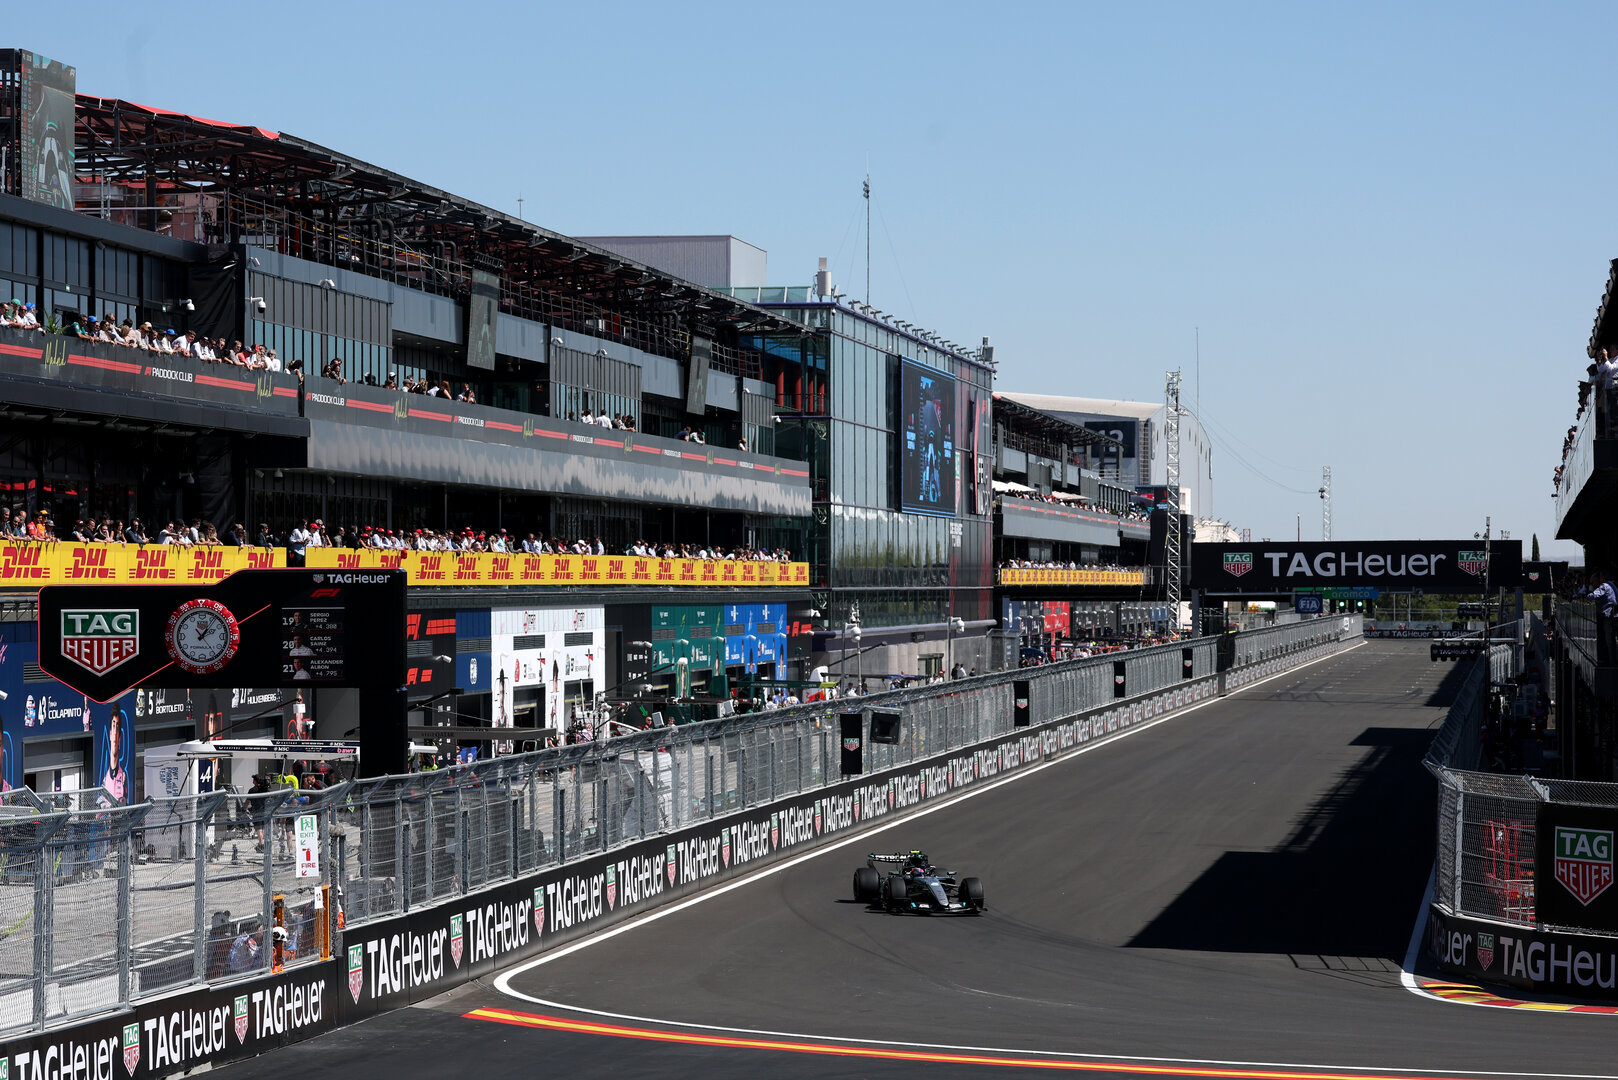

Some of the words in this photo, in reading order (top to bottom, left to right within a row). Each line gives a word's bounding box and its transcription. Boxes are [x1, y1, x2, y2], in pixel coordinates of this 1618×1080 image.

[151, 367, 179, 380] PADDOCK
[178, 373, 193, 382] CLUB
[312, 393, 333, 405] PADDOCK
[333, 397, 345, 406] CLUB
[1, 547, 44, 579] DHL
[70, 548, 112, 579] DHL
[134, 550, 171, 579] DHL
[192, 551, 227, 579] DHL
[419, 556, 443, 580] DHL
[456, 557, 478, 580] DHL
[1226, 554, 1250, 562] TAG
[1264, 552, 1446, 577] TAGHeuer
[327, 574, 391, 584] TAGHeuer
[490, 558, 511, 580] DHL
[523, 558, 542, 580] DHL
[552, 559, 572, 580] DHL
[581, 559, 599, 580] DHL
[608, 560, 625, 580] DHL
[633, 561, 649, 580] DHL
[657, 561, 673, 580] DHL
[681, 563, 695, 581] DHL
[702, 563, 716, 581] DHL
[723, 564, 735, 581] DHL
[742, 564, 755, 581] DHL
[1225, 563, 1252, 575] HEUER
[310, 588, 341, 598] F1
[1332, 590, 1370, 598] aramco
[1300, 600, 1319, 609] FIA
[68, 614, 131, 633] TAG
[228, 615, 235, 623] 10
[282, 617, 295, 625] 19
[66, 640, 133, 670] HEUER
[282, 641, 295, 649] 20
[282, 665, 295, 673] 21
[38, 696, 47, 726] 43
[48, 707, 82, 720] COLAPINTO
[148, 691, 154, 715] 5
[156, 704, 184, 714] BORTOLETO
[822, 795, 853, 834] TAGHeuer
[779, 806, 814, 848] TAGHeuer
[731, 820, 770, 865] TAGHeuer
[1560, 832, 1608, 858] TAG
[678, 836, 720, 884] TAGHeuer
[618, 853, 665, 907] TAGHeuer
[1558, 862, 1610, 900] HEUER
[535, 889, 544, 907] TAG
[547, 872, 604, 932] TAGHeuer
[451, 916, 463, 936] TAG
[466, 898, 531, 964] TAGHeuer
[1479, 934, 1493, 948] TAG
[349, 947, 363, 968] TAG
[367, 928, 447, 999] TAGHeuer
[1478, 950, 1493, 969] HEUER
[1500, 936, 1616, 988] TAGHeu
[235, 997, 248, 1015] TAG
[252, 979, 325, 1040] TAGHeuer
[125, 1025, 139, 1044] TAG
[144, 1004, 230, 1071] TAGHeuer
[15, 1035, 119, 1080] TAGHeuer
